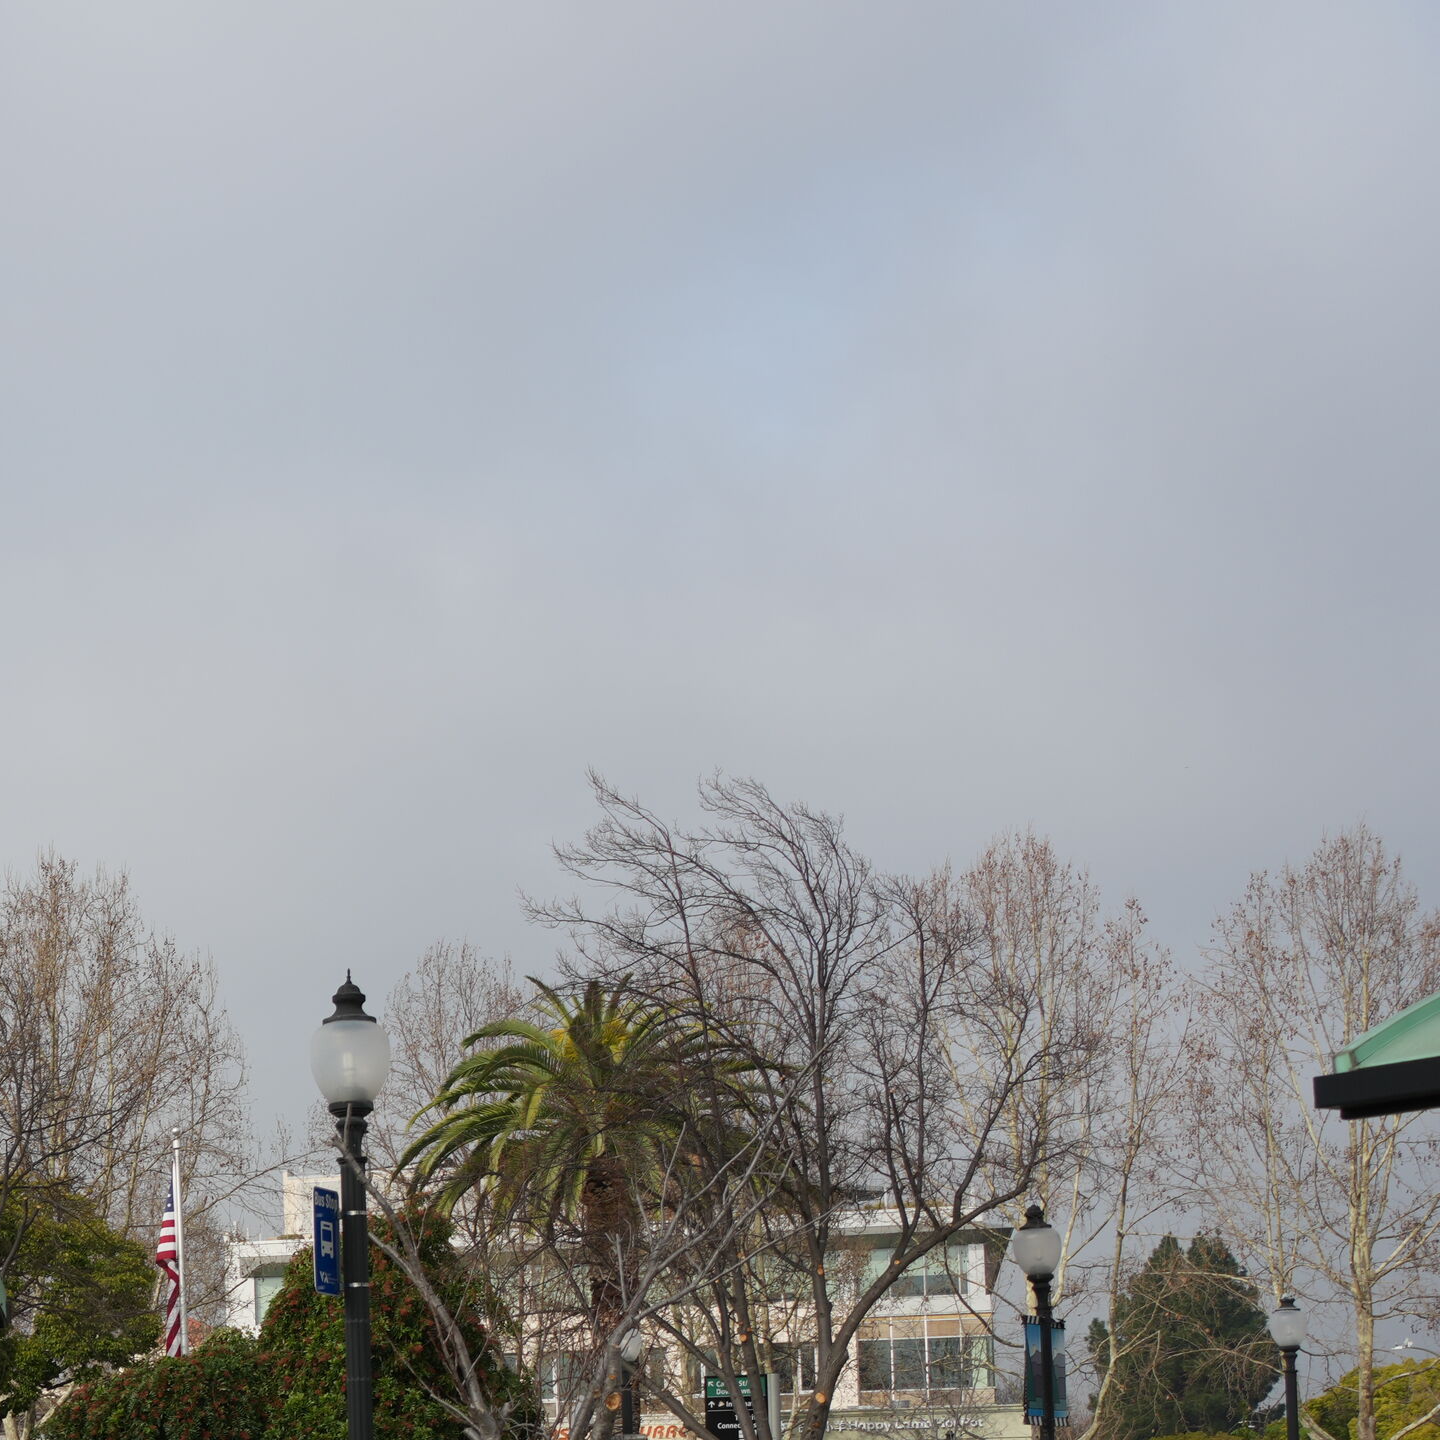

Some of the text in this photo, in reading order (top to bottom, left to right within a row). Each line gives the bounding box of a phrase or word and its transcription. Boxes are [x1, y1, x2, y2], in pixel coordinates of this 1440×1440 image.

[314, 1191, 338, 1213] Bus Stop
[848, 1420, 891, 1432] Happy
